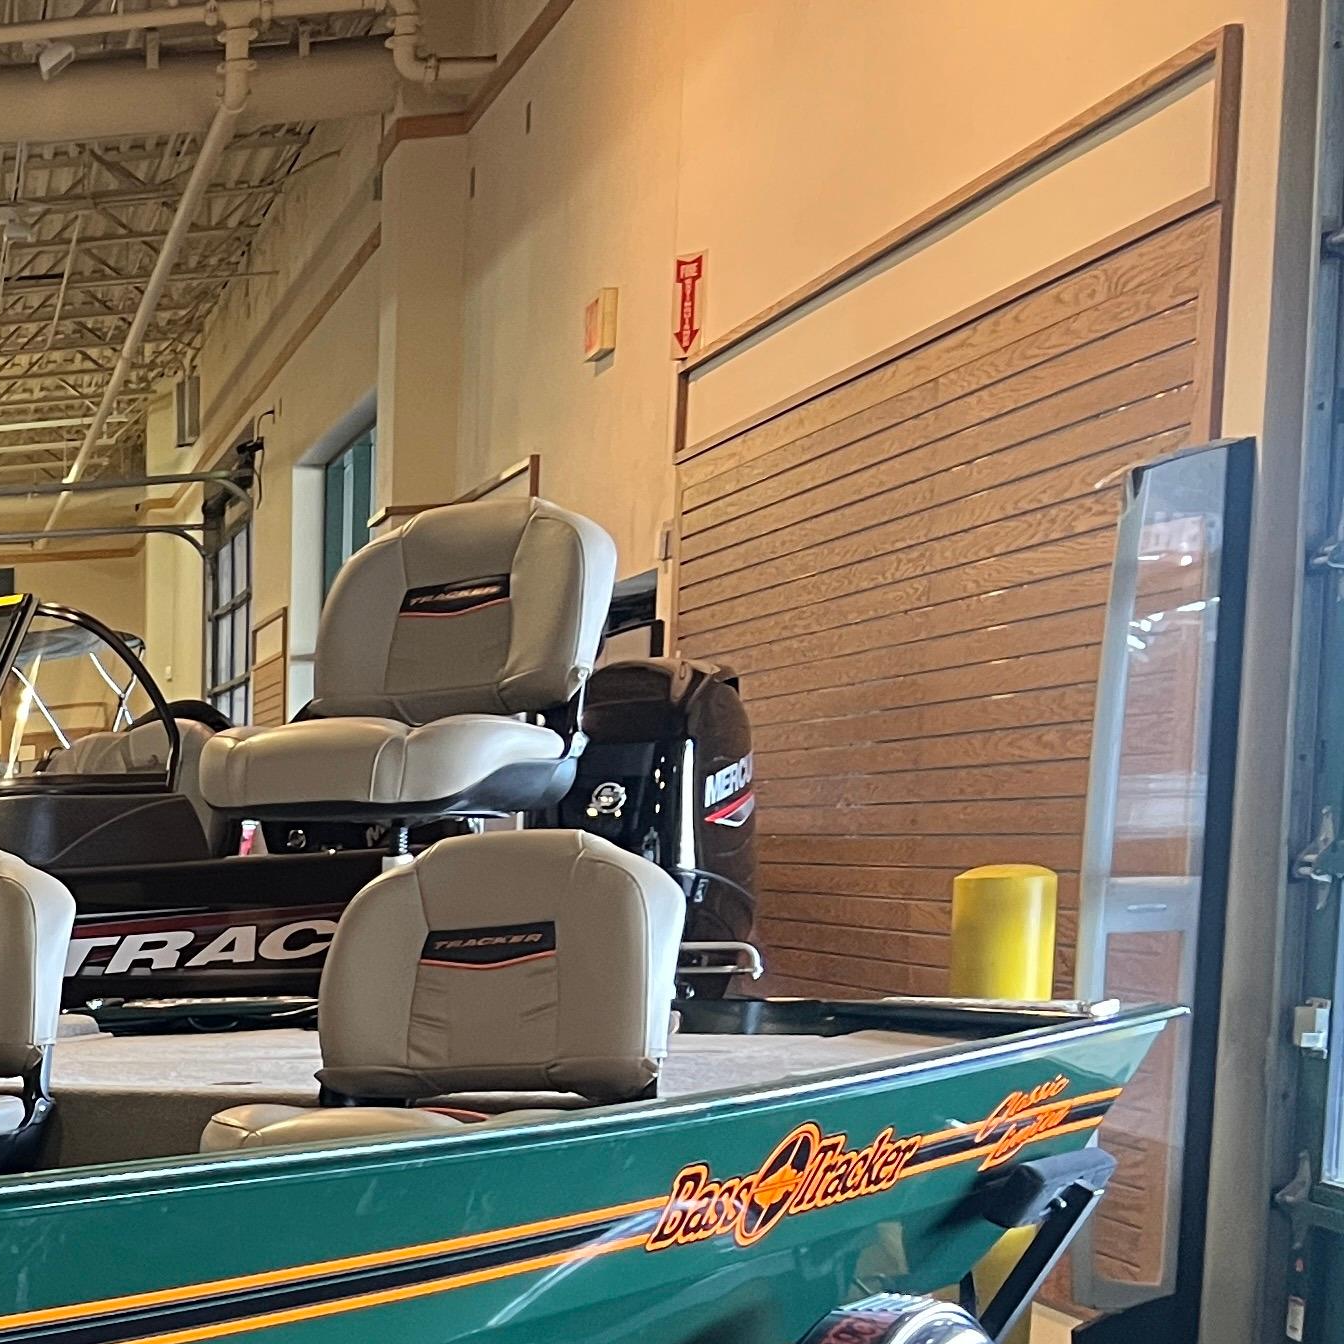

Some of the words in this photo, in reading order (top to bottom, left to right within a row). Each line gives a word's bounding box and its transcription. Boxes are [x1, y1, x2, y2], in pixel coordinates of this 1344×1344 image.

[63, 919, 339, 978] TRAC
[433, 932, 544, 950] TRACKER
[645, 1161, 754, 1252] Bass
[789, 1127, 925, 1215] Tracker
